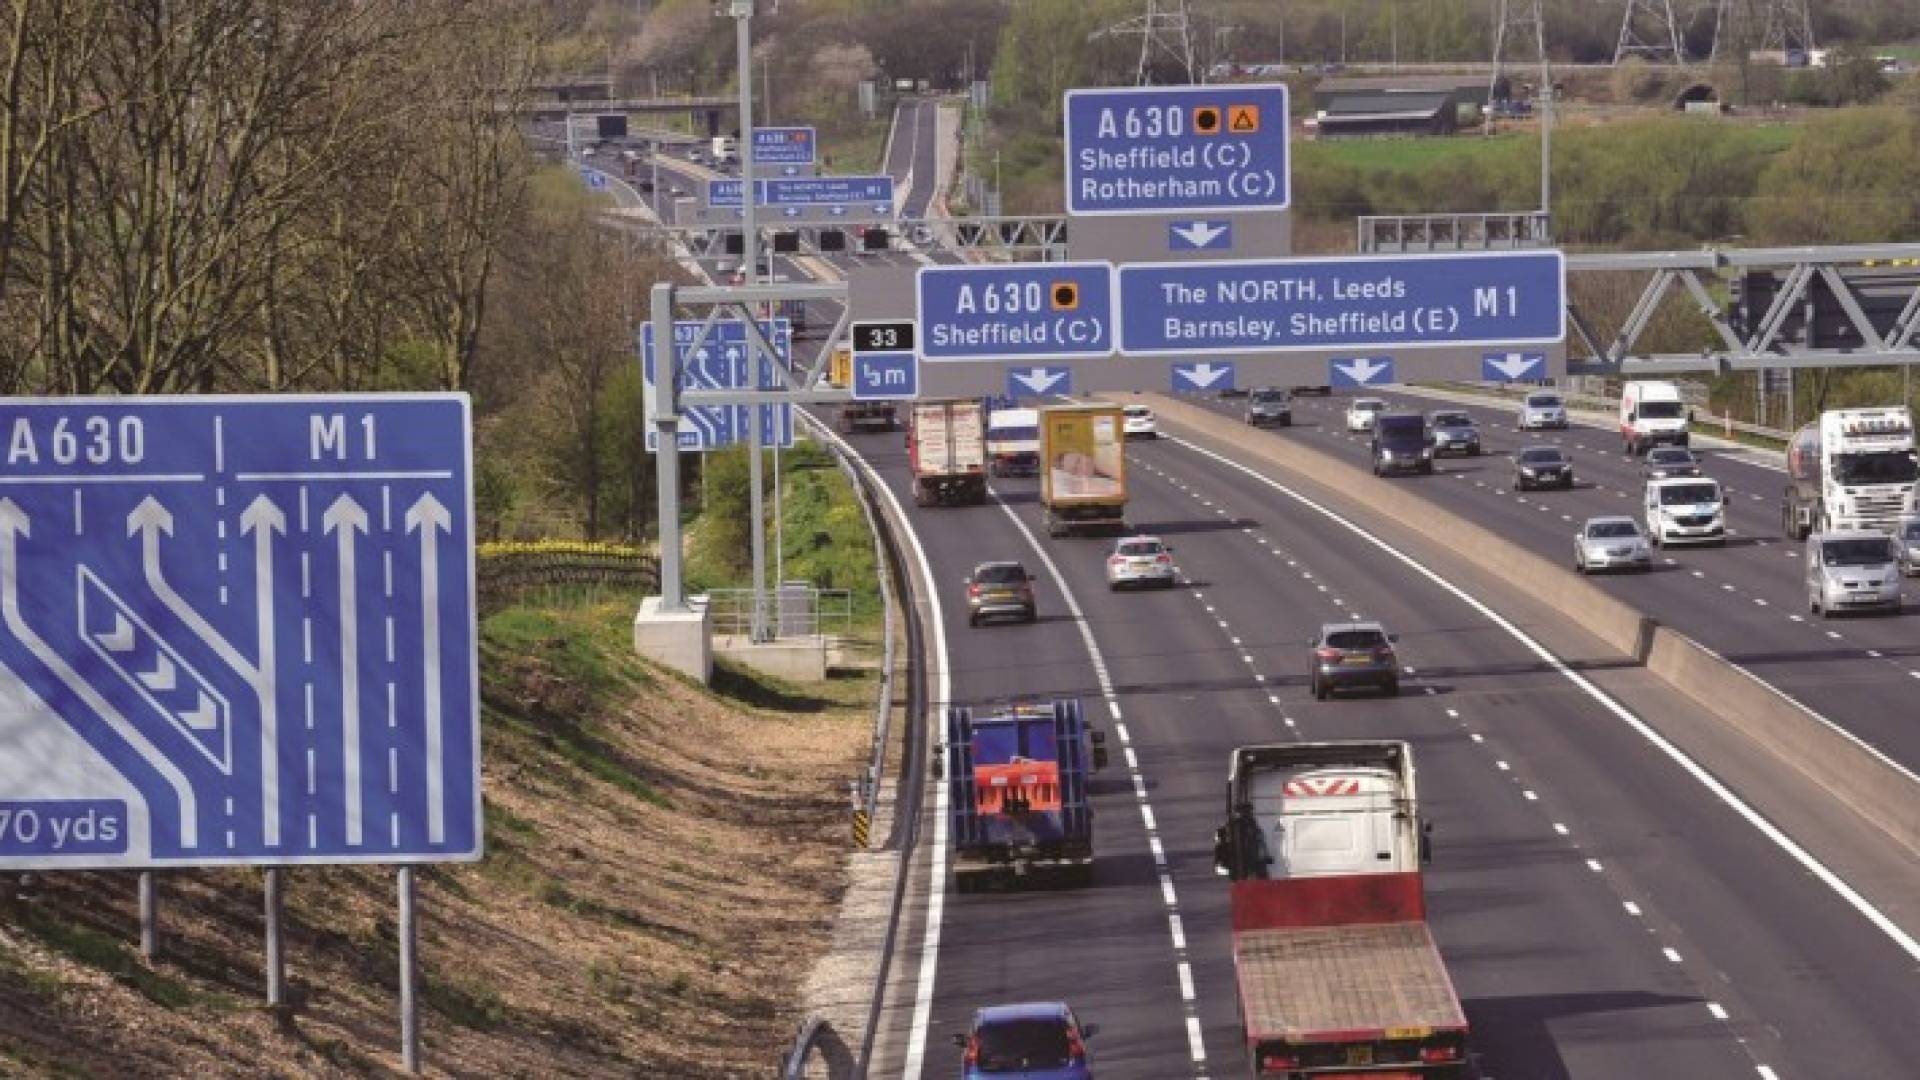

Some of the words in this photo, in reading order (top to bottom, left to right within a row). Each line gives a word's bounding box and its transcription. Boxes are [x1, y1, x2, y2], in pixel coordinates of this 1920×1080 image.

[1098, 105, 1184, 138] A630
[1080, 145, 1195, 171] Sheffield
[1203, 141, 1251, 169] (C)
[1082, 175, 1222, 200] Rotherham
[1228, 170, 1276, 197] (C)
[956, 281, 1041, 314] A630
[1161, 282, 1208, 304] The
[1333, 275, 1406, 299] Leeds
[1474, 285, 1517, 318] M1
[933, 321, 1047, 347] Sheffield
[1054, 318, 1102, 345] (C)
[1290, 310, 1406, 336] Sheffield
[1412, 305, 1459, 334] (E)
[870, 328, 897, 347] 33
[8, 415, 145, 465] A630
[310, 413, 376, 461] M1
[48, 808, 118, 849] yds
